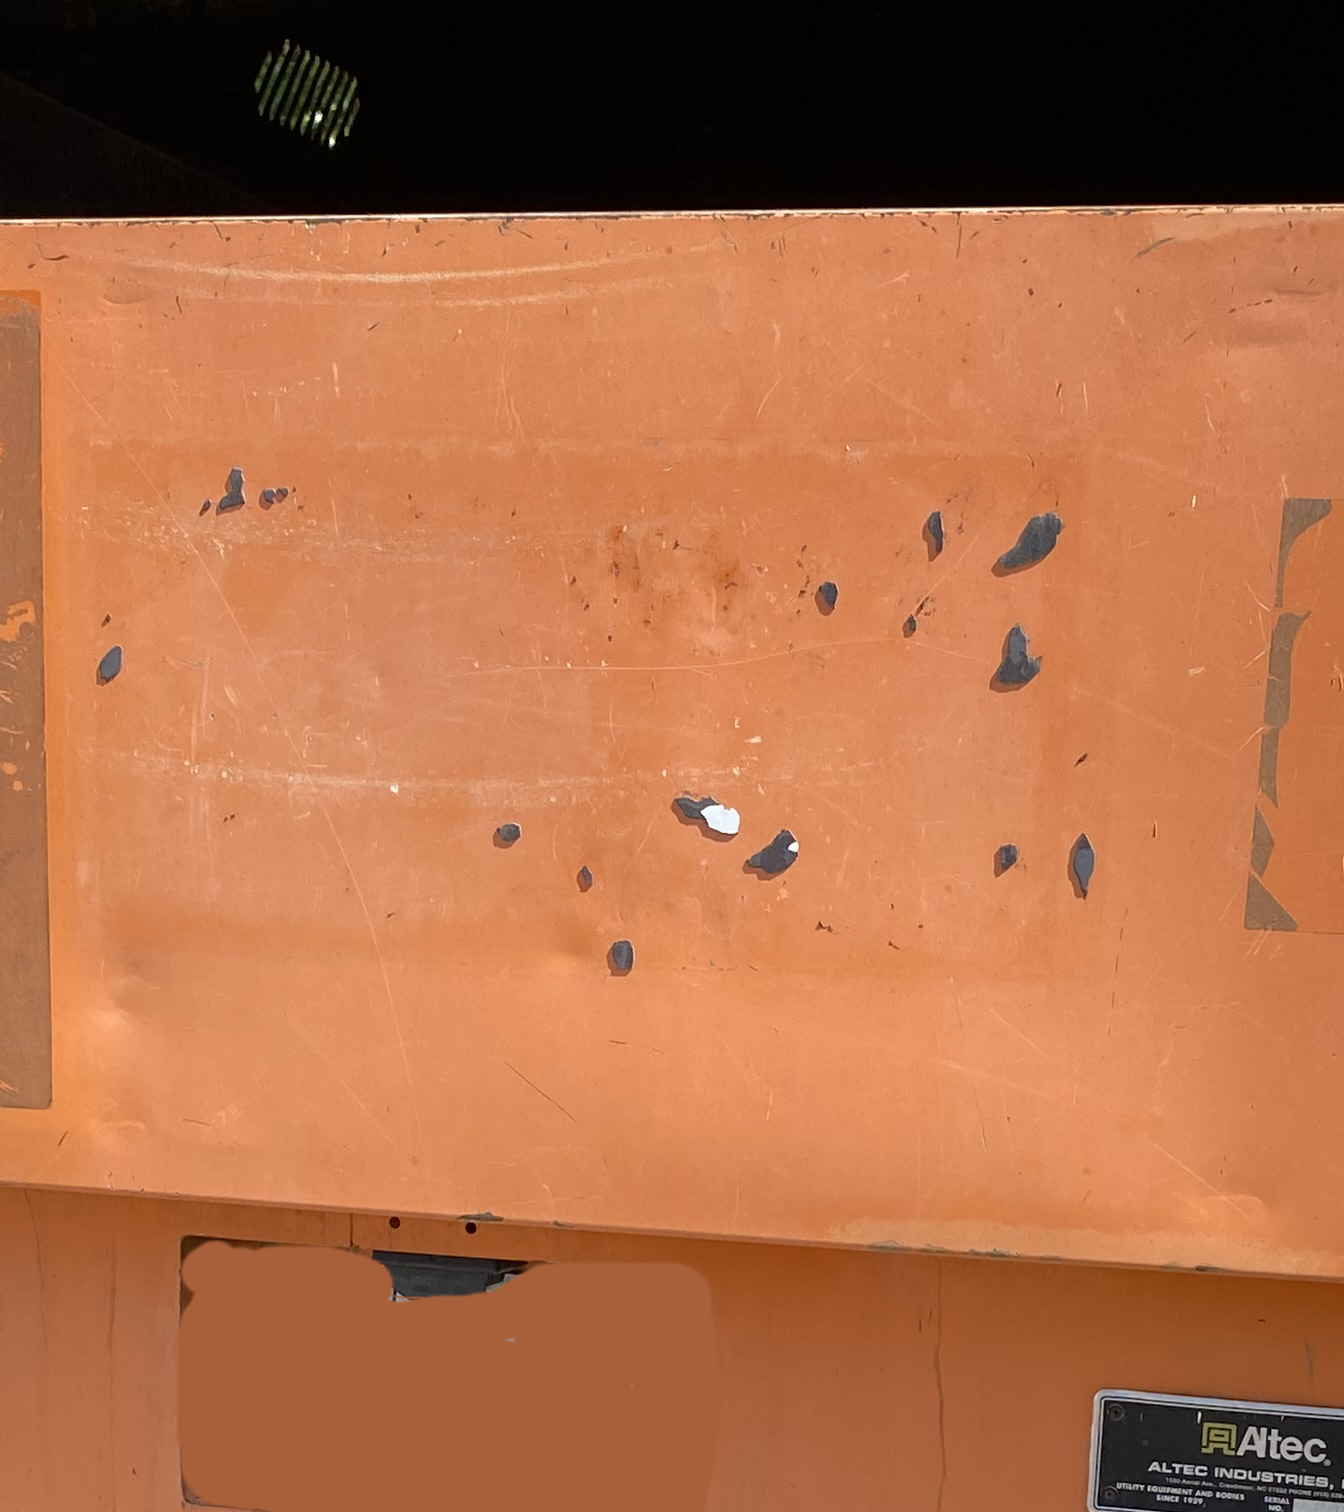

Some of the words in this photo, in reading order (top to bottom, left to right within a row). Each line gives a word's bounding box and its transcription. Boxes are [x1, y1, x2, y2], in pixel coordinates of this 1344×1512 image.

[1237, 1426, 1327, 1463] Altec
[1147, 1461, 1208, 1476] ALTEC
[1214, 1467, 1334, 1490] INDUSTRIES,
[1116, 1482, 1145, 1492] UTILITY
[1147, 1484, 1193, 1496] EQUIPMENT
[1195, 1489, 1213, 1498] AND
[1216, 1491, 1245, 1500] BODIES
[1156, 1494, 1180, 1503] SINCE
[1264, 1495, 1290, 1505] SERIAL
[1268, 1504, 1284, 1512] NO.
